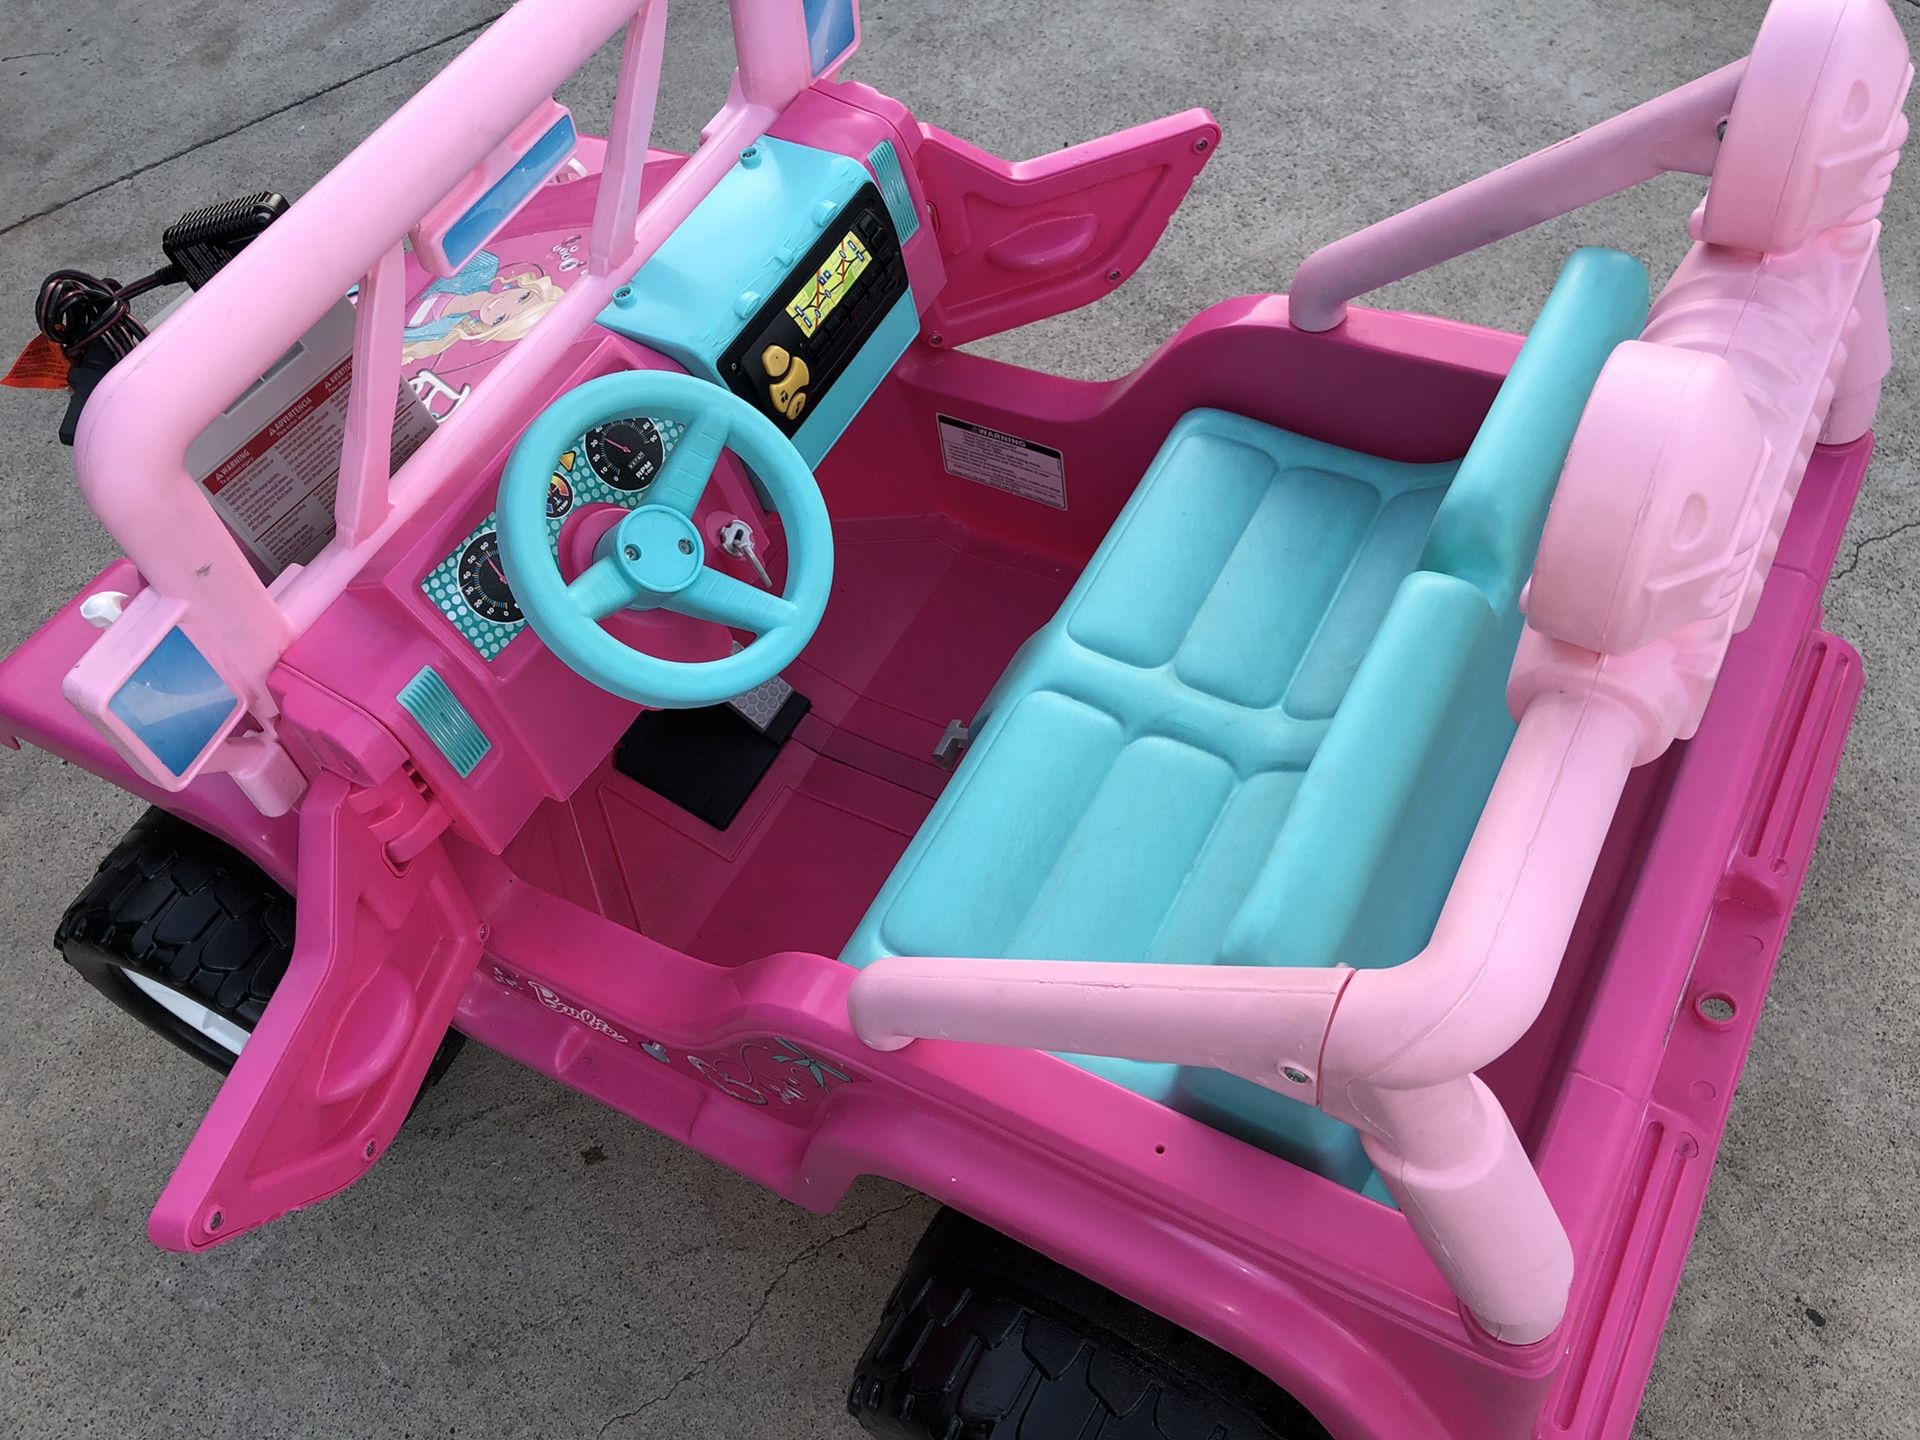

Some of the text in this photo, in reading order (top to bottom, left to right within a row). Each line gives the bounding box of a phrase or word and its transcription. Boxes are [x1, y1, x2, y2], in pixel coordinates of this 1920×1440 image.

[274, 397, 312, 428] ADVERTENCIA
[978, 424, 1026, 448] WARNING
[590, 439, 598, 447] 30
[220, 449, 250, 475] WARNING
[593, 454, 600, 462] 20
[600, 466, 608, 475] 10
[635, 460, 651, 478] RPM
[557, 500, 568, 512] TEMP
[480, 542, 489, 550] 60
[468, 555, 476, 564] 50
[463, 571, 471, 580] 40
[465, 586, 474, 595] 30
[474, 600, 483, 608] 20
[486, 607, 495, 615] 10
